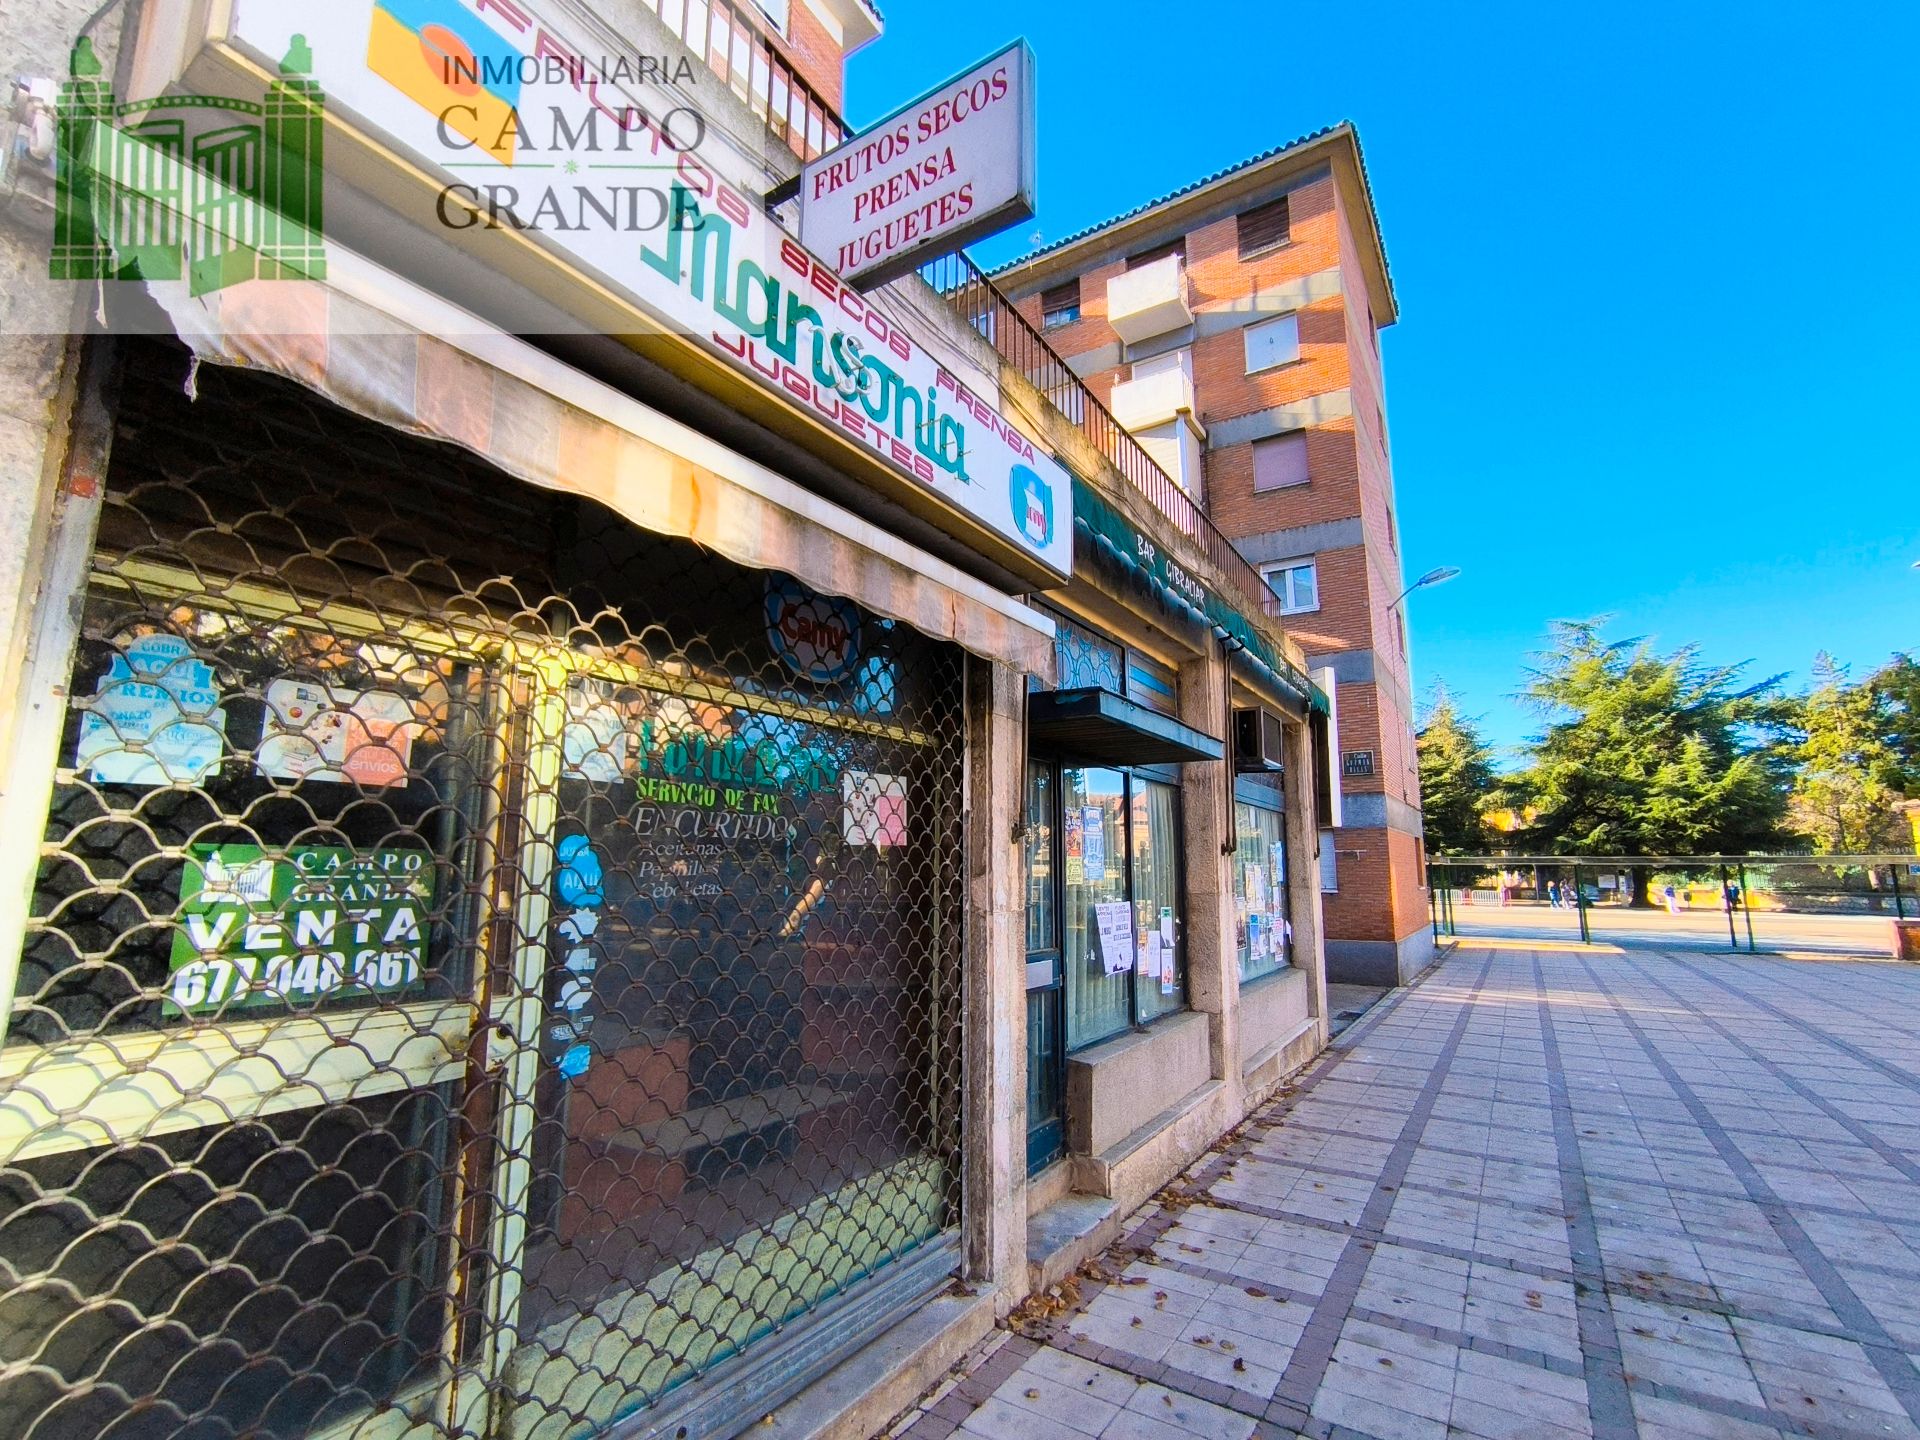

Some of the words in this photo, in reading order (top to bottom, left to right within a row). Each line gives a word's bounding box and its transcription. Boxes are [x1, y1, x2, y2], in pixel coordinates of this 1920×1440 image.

[813, 124, 909, 200] FRUTOS
[917, 67, 1009, 145] SECOS
[852, 146, 957, 224] PRENSA
[476, 0, 751, 229] FRUTOS
[781, 238, 910, 361] SECOS
[935, 367, 1035, 466] PRENSA
[835, 182, 974, 274] JUGUETES
[712, 331, 935, 482] JUGUETES
[1137, 534, 1156, 568] BAR
[1165, 560, 1206, 609] GIBRALTAR
[110, 683, 217, 705] REIOS
[636, 776, 717, 807] SERVICIO
[724, 788, 746, 811] DE
[753, 792, 780, 815] FAX
[632, 806, 794, 842] ENCURTIDO
[296, 852, 423, 871] CAMPO
[639, 860, 720, 882] Pepnills
[639, 881, 723, 899] Ceboetas
[187, 907, 421, 950] VENTA
[173, 957, 257, 1007] 677
[264, 951, 346, 996] 048
[354, 947, 421, 989] 661
